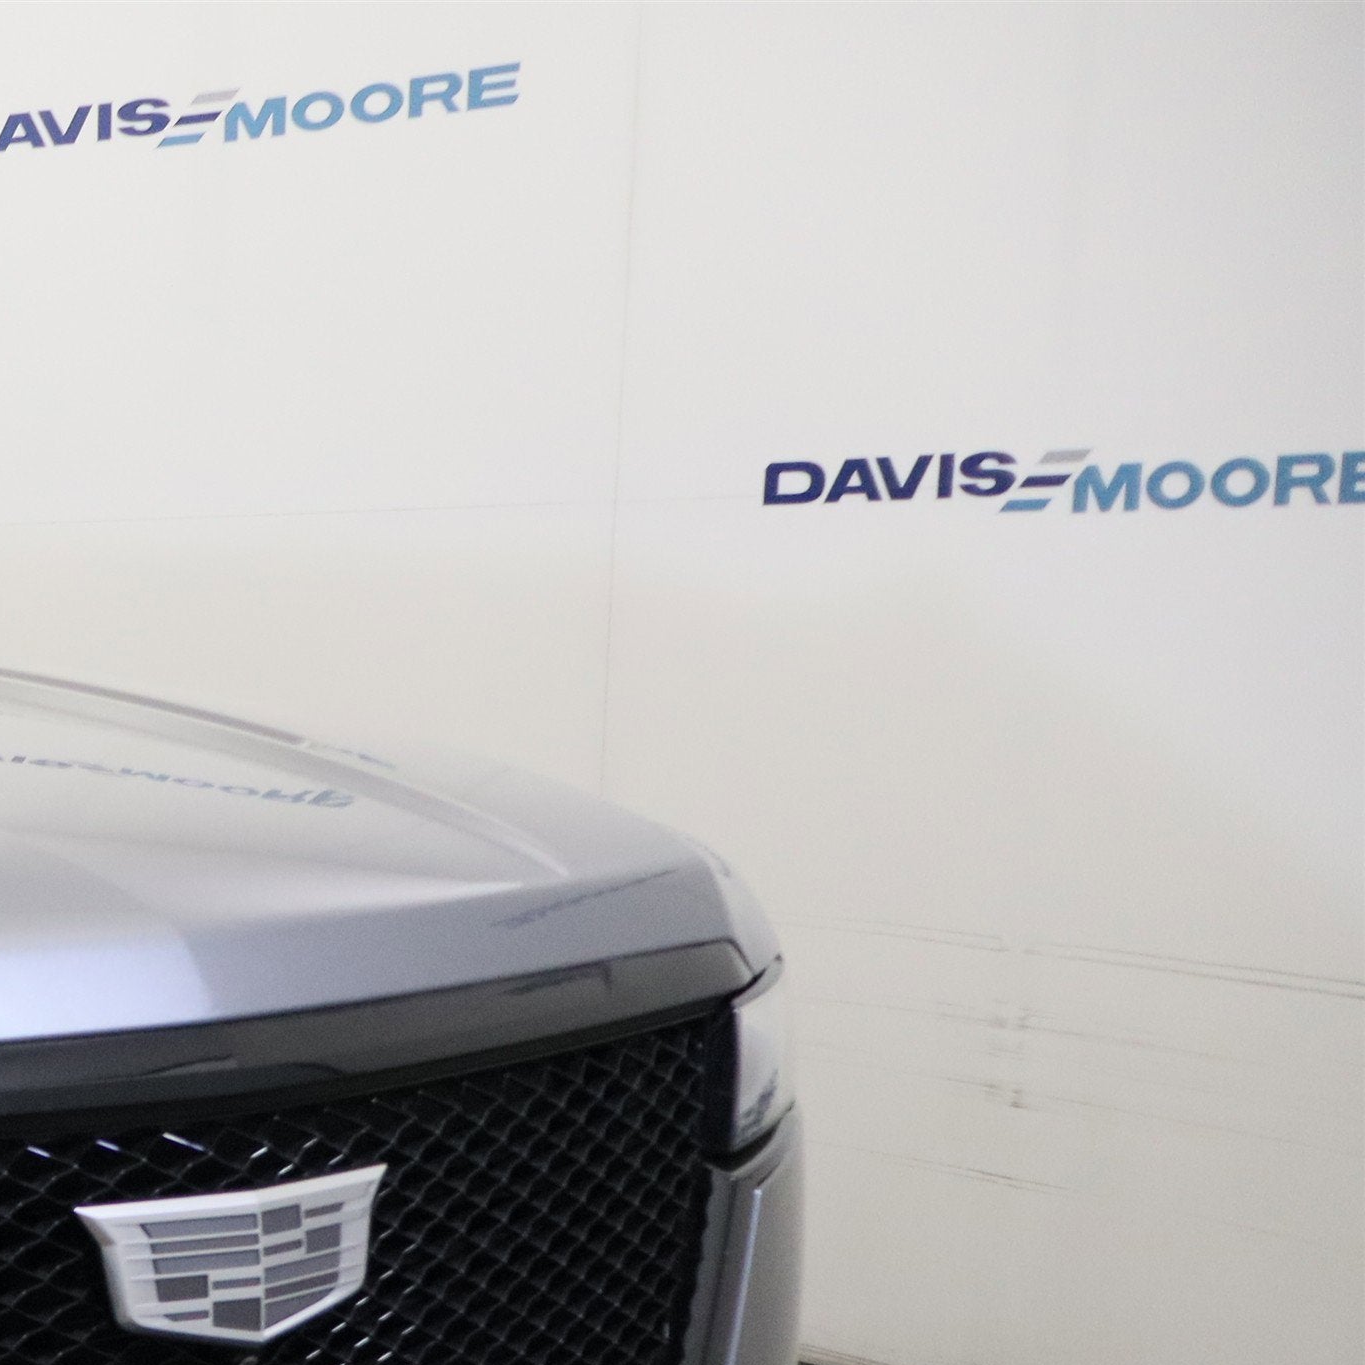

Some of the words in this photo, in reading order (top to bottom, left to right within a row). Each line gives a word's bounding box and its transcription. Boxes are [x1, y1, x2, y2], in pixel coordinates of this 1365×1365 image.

[224, 61, 522, 143] MOORE
[762, 451, 1015, 506] DAVIS
[1072, 450, 1365, 513] MOORE
